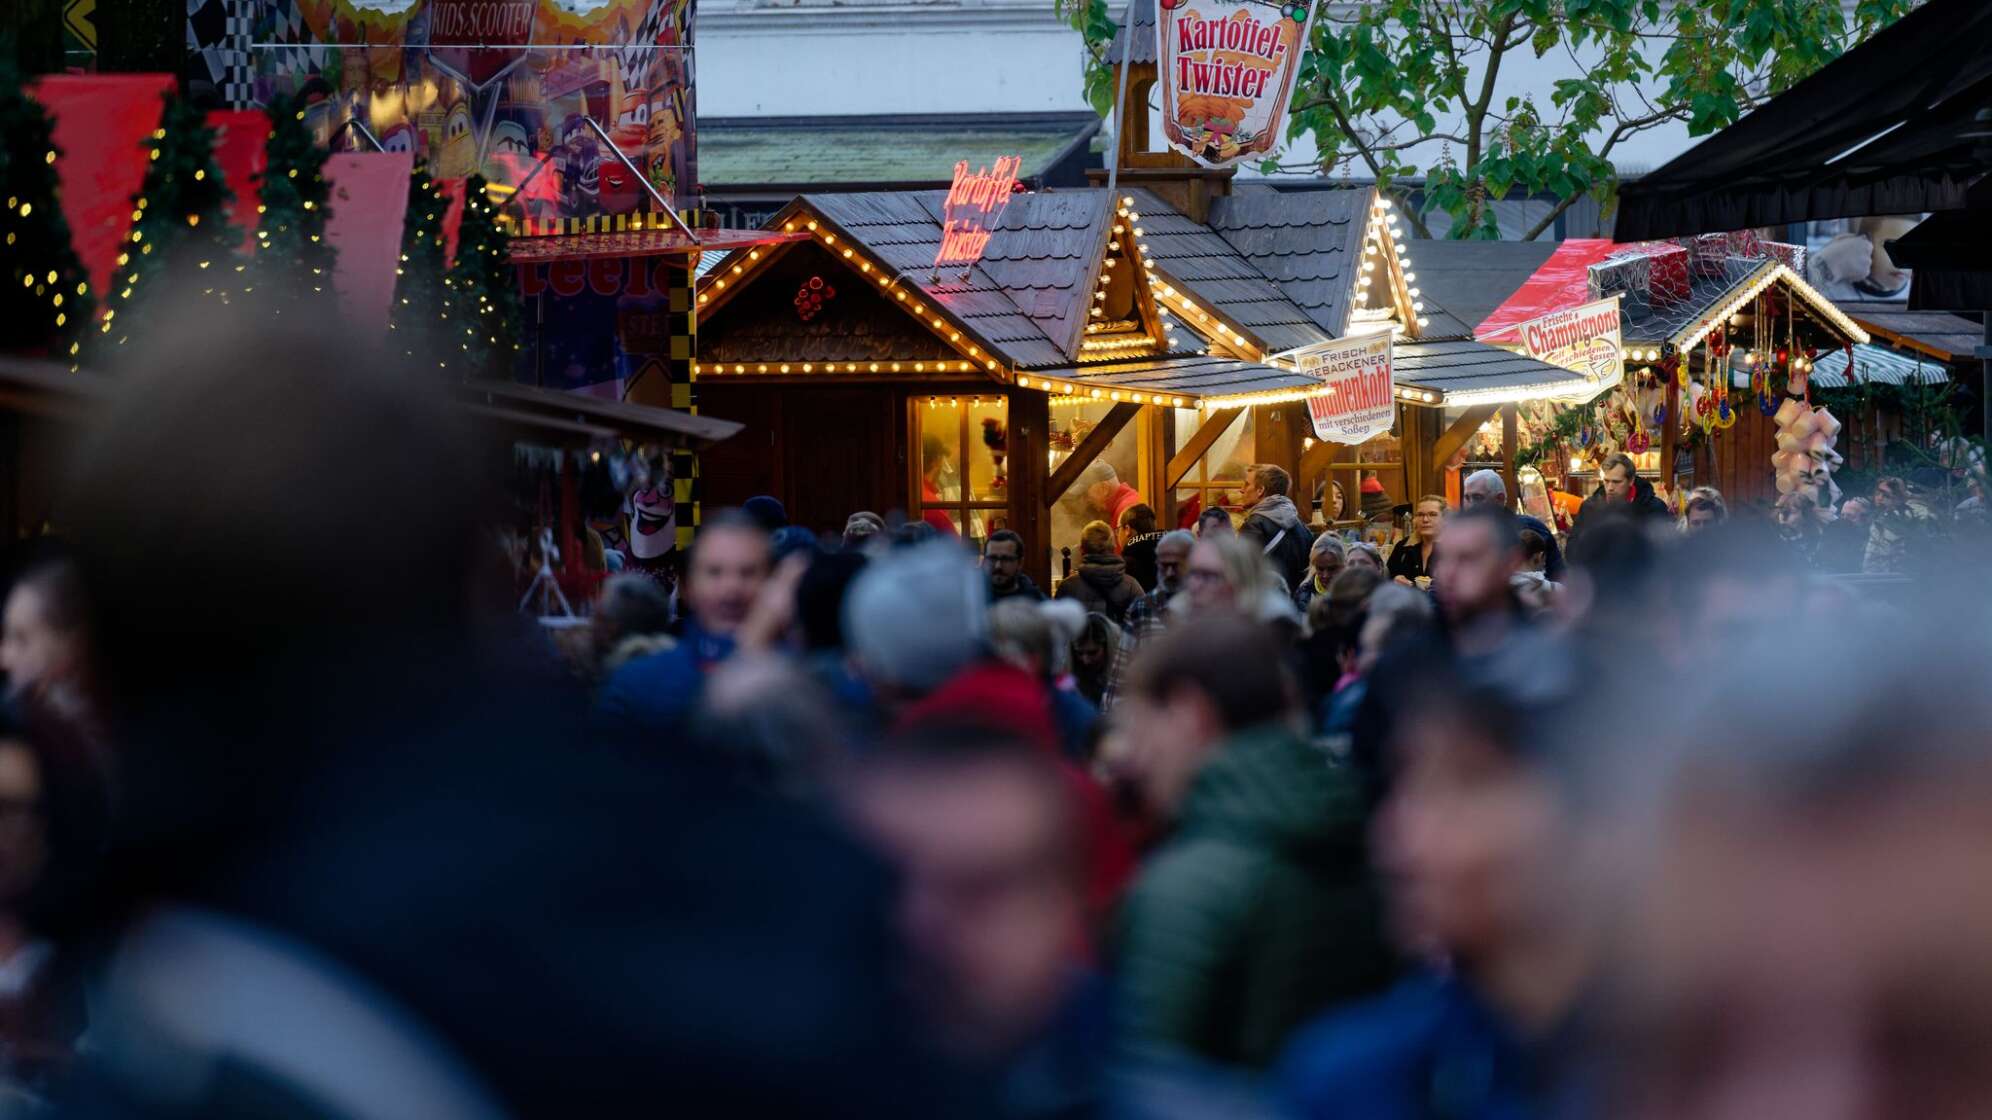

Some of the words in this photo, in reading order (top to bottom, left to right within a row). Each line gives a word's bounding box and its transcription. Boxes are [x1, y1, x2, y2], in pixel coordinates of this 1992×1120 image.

[1177, 16, 1286, 60] Kartoffel-
[1177, 56, 1271, 99] Twister
[944, 155, 1021, 213] Kartoffel
[935, 219, 991, 266] Twister
[1527, 309, 1618, 355] Champignons
[1306, 354, 1386, 377] GEBACKENER
[1321, 347, 1367, 363] FRISCH
[1318, 421, 1334, 431] mit
[1334, 408, 1391, 427] verschiedenen
